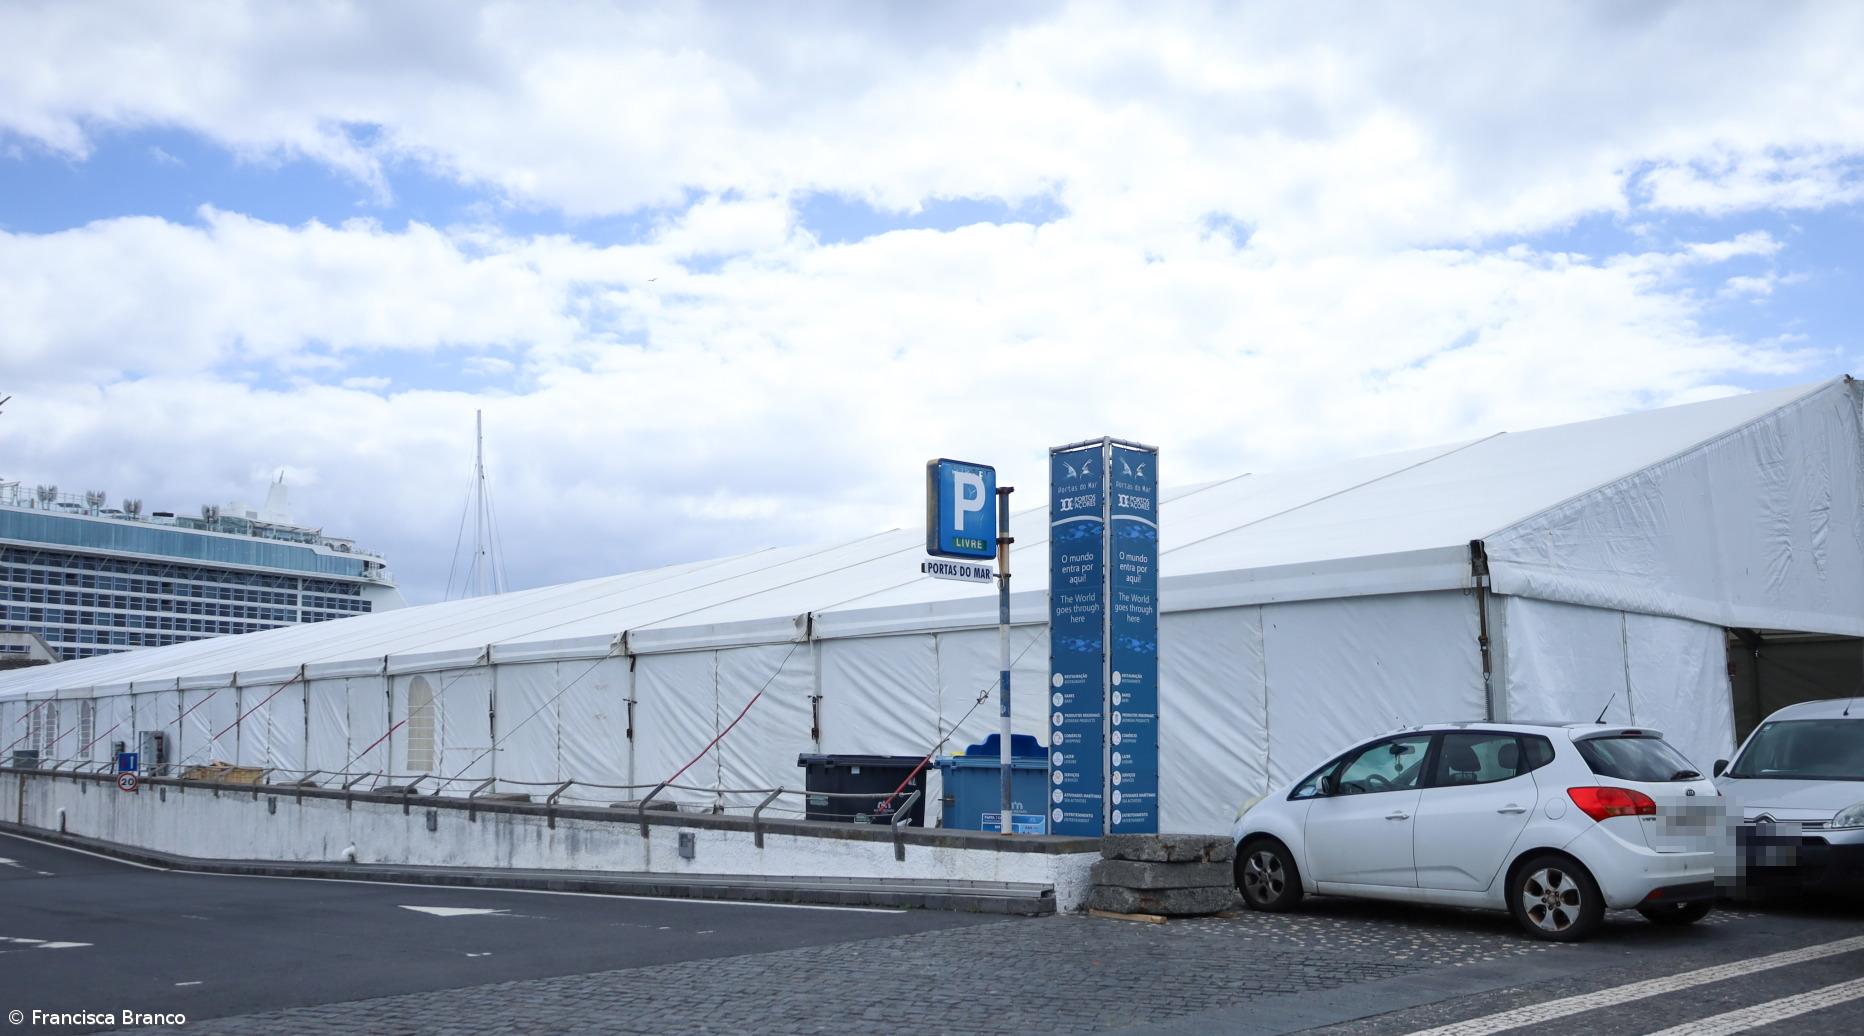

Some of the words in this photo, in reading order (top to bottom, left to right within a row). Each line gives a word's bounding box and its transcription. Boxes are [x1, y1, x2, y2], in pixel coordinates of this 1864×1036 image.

[1058, 485, 1078, 493] Portas
[1115, 481, 1133, 490] Portas
[954, 470, 986, 531] P
[1074, 494, 1096, 502] PORTOS
[1130, 496, 1150, 504] PORTOS
[956, 537, 983, 550] LIVRE
[1061, 555, 1068, 563] O
[1069, 552, 1094, 562] mundo
[1119, 552, 1125, 560] O
[1126, 554, 1148, 563] mundo
[928, 562, 957, 576] PORTAS
[960, 566, 971, 577] DO
[974, 567, 991, 580] MAR
[1062, 565, 1080, 574] entra
[1081, 563, 1094, 573] por
[1120, 563, 1136, 572] entra
[1136, 566, 1148, 574] por
[1060, 595, 1073, 604] The
[1075, 592, 1096, 602] World
[1118, 592, 1130, 602] The
[1130, 594, 1150, 603] World
[1056, 606, 1072, 616] goes
[1073, 603, 1100, 614] through
[1114, 604, 1129, 612] goes
[1129, 604, 1153, 615] through
[1070, 615, 1086, 623] here
[1126, 614, 1140, 622] here
[121, 778, 134, 786] 20
